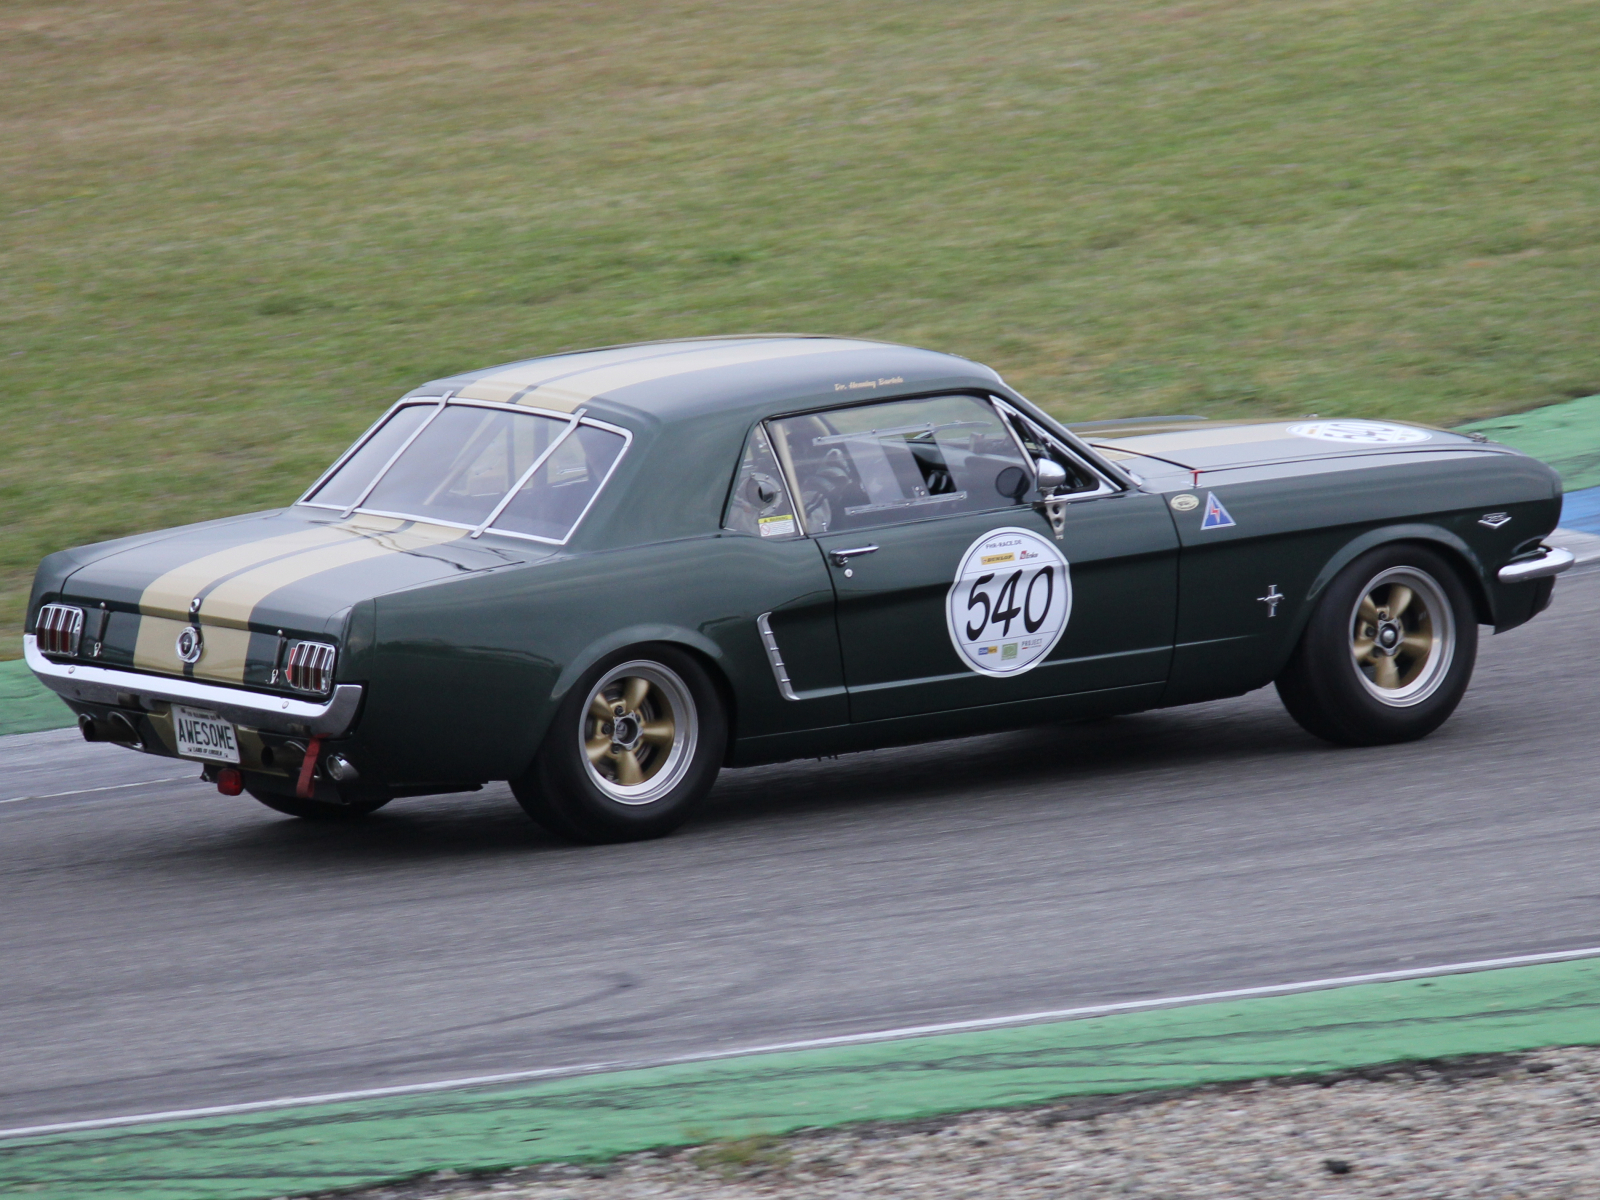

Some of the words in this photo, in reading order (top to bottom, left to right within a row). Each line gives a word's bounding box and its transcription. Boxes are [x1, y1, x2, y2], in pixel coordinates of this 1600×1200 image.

[987, 554, 1013, 562] DUNLOP
[966, 565, 1053, 641] 540
[178, 718, 235, 750] AWESOME
